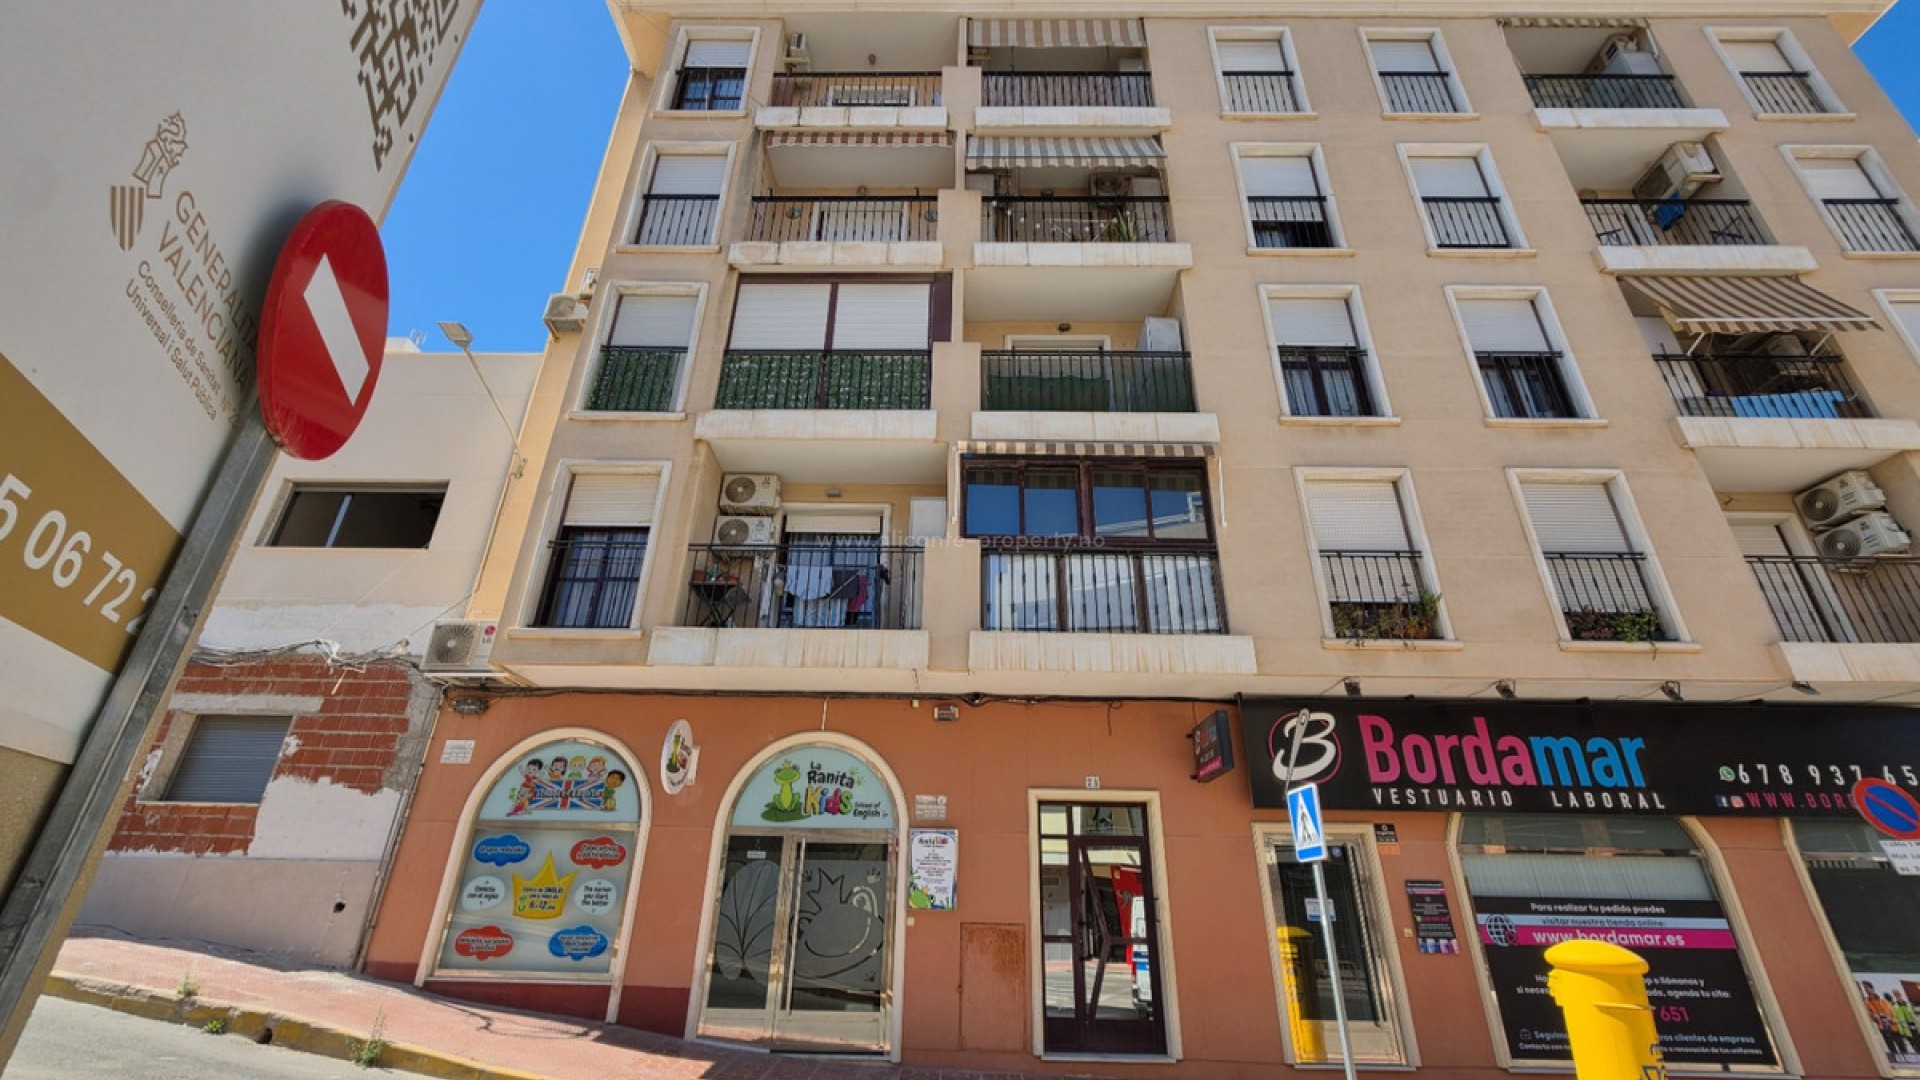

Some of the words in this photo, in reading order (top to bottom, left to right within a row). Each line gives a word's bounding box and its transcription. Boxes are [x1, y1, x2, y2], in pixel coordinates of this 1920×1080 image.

[176, 191, 257, 354] GENERALITA
[158, 220, 248, 393] VALENCIANA
[126, 279, 170, 348] Universal
[170, 347, 193, 384] Salut
[138, 260, 186, 341] Conselleria
[185, 337, 196, 356] de
[195, 351, 222, 394] Sanitat
[23, 510, 92, 588] 06
[83, 551, 137, 623] 72
[1358, 715, 1646, 788] Bordamar
[810, 761, 822, 770] La
[1738, 763, 1794, 785] 678
[1807, 764, 1862, 786] 937
[807, 770, 855, 789] Ranita
[804, 785, 853, 816] Kids
[1373, 788, 1513, 807] VESTUARIO
[1551, 792, 1666, 810] LABORAL
[853, 808, 881, 820] English
[1530, 902, 1552, 912] Para
[1553, 903, 1587, 912] realizar
[1589, 904, 1599, 912] tu
[1600, 904, 1631, 914] pedido
[1632, 905, 1666, 914] puedes
[1541, 917, 1568, 926] visitar
[1605, 918, 1635, 928] tienda
[1532, 928, 1686, 946] wwwbordamar.es
[1660, 1005, 1689, 1023] 651
